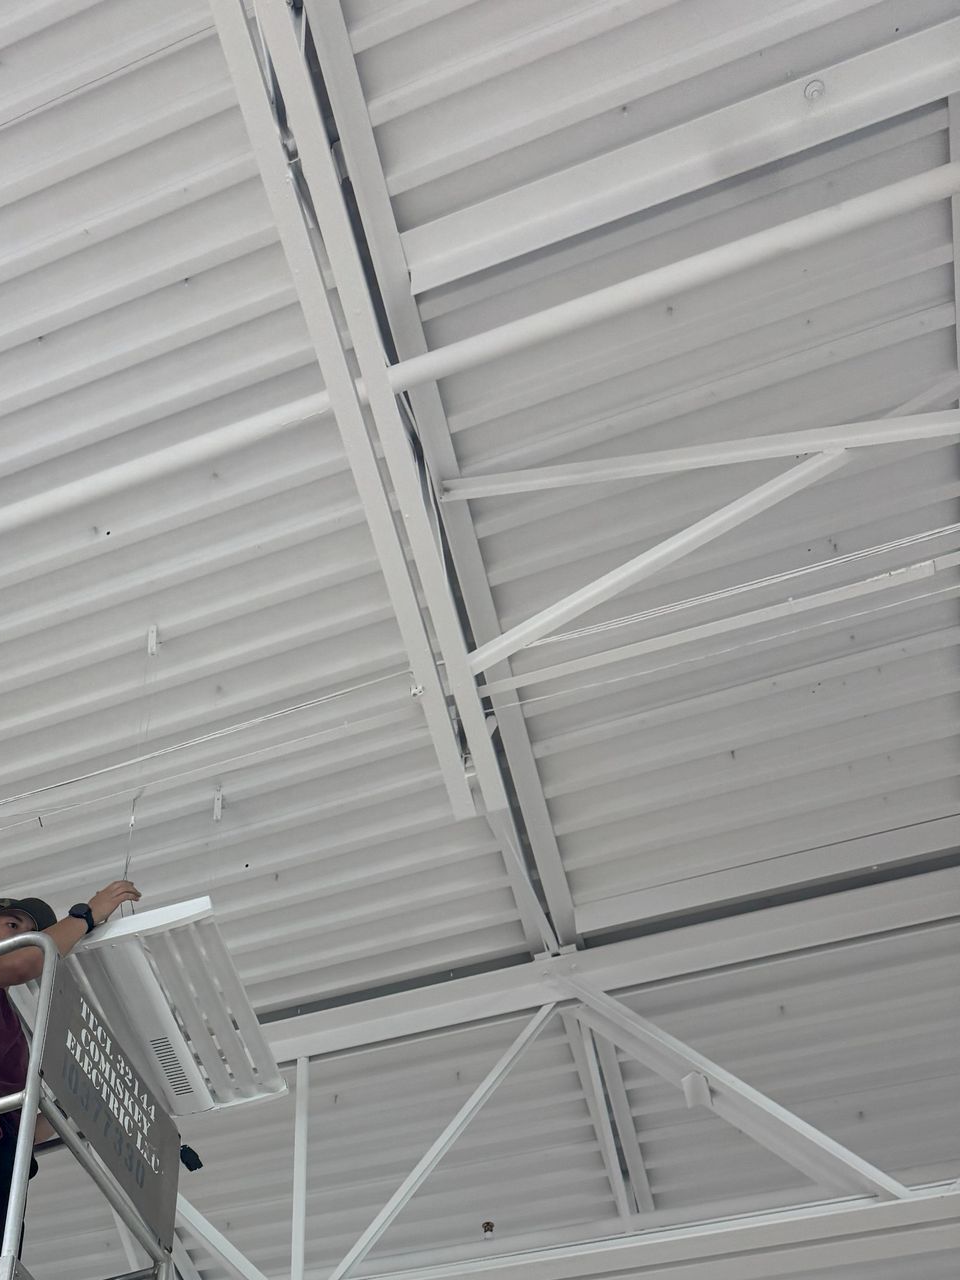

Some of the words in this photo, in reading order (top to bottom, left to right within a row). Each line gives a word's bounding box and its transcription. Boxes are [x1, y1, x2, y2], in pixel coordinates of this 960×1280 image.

[66, 1029, 134, 1137] ELECTRIC
[80, 996, 113, 1060] TECL
[116, 1054, 156, 1121] 32144
[80, 1028, 151, 1137] COMISKEY
